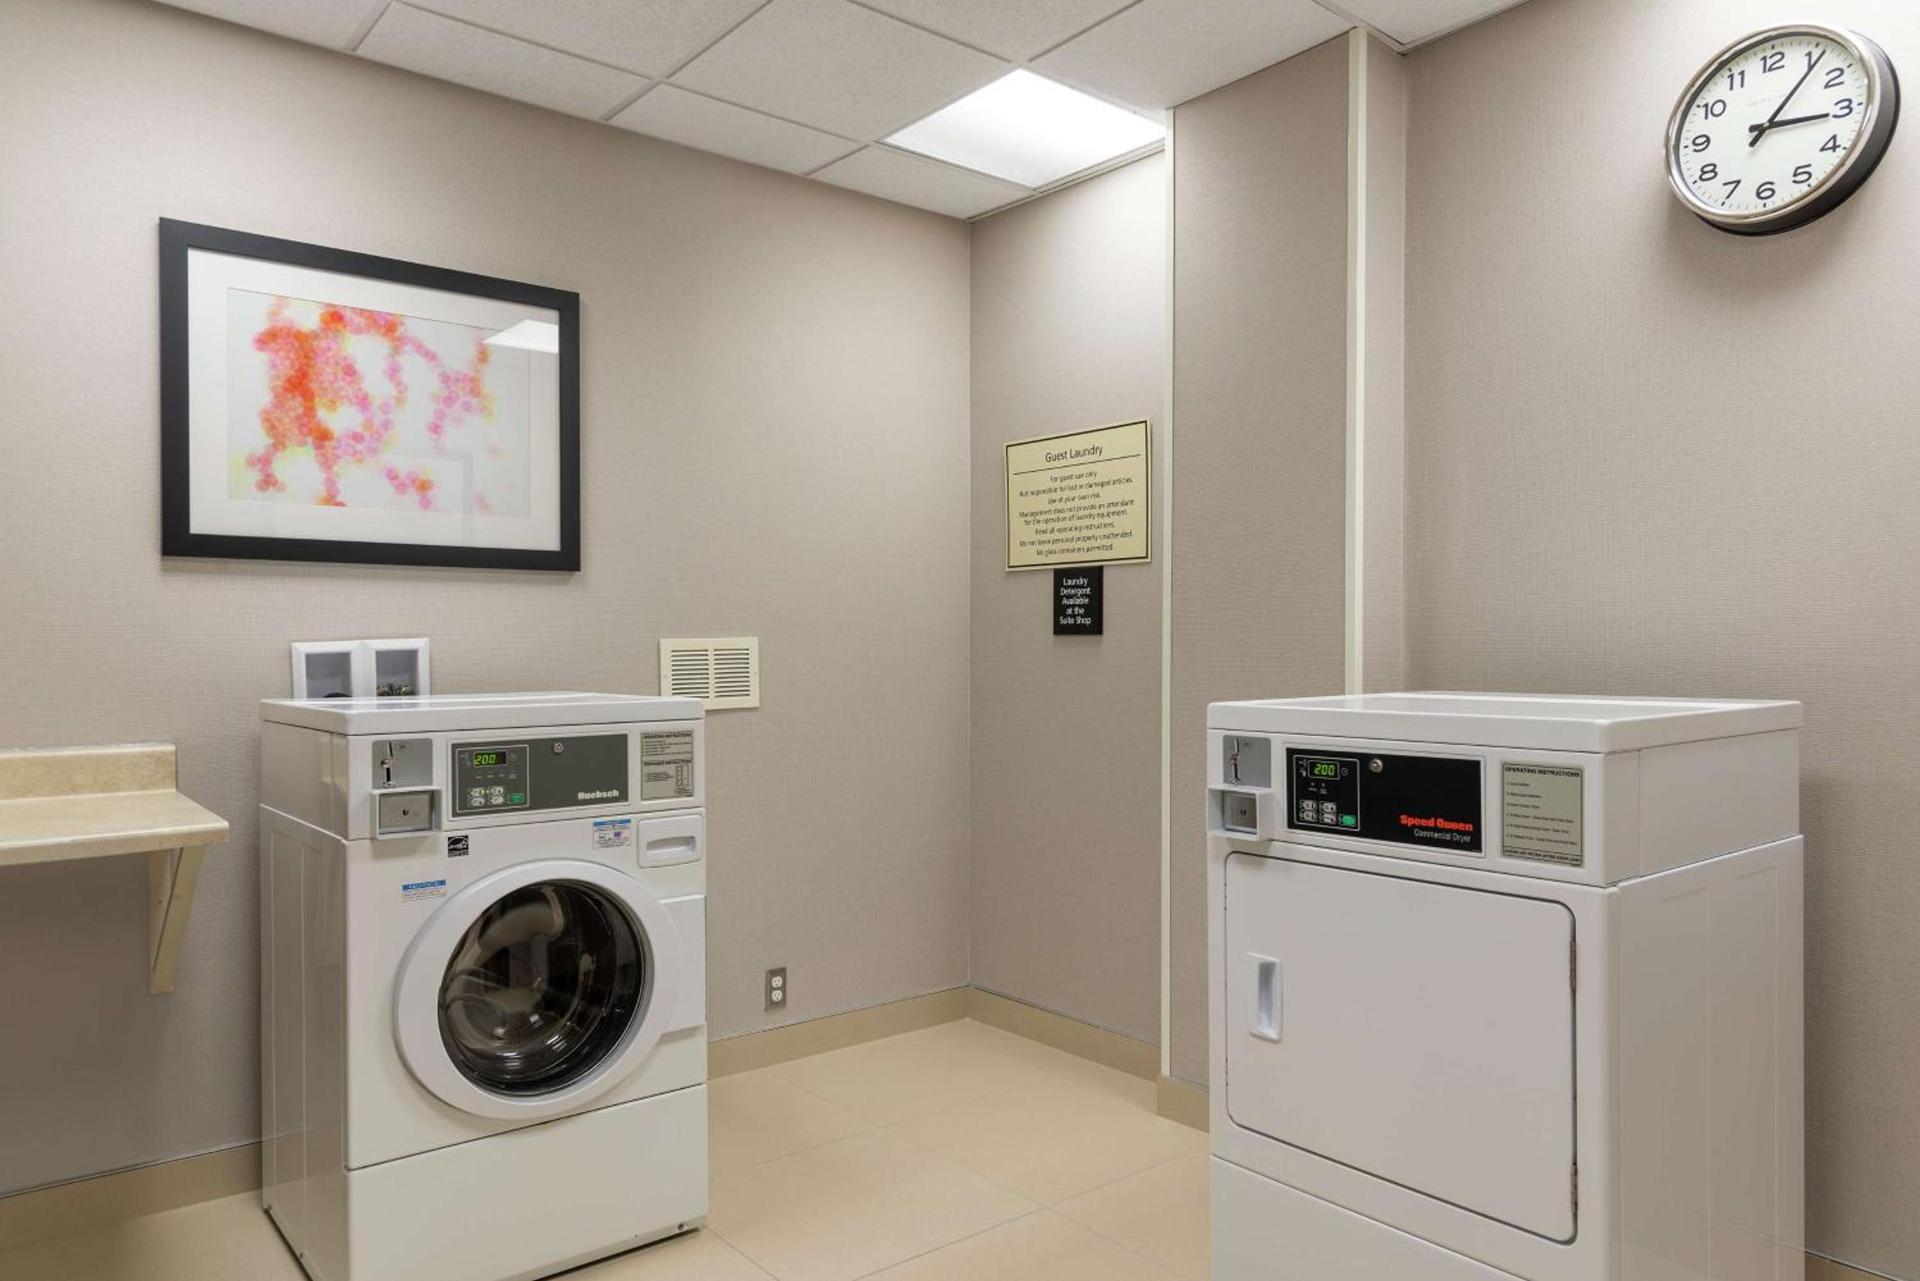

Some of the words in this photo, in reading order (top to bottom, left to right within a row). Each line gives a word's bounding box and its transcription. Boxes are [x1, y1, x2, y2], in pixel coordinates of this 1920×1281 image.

[1760, 51, 1785, 73] 12
[1804, 51, 1814, 69] 1
[1727, 70, 1746, 91] 11
[1823, 67, 1845, 89] 2
[1702, 99, 1727, 120] 10
[1831, 98, 1854, 118] 3
[1691, 134, 1711, 152] 9
[1819, 134, 1842, 153] 4
[1698, 163, 1718, 181] 8
[1792, 164, 1813, 184] 5
[1722, 179, 1742, 200] 7
[1755, 181, 1776, 200] 6
[1045, 450, 1068, 462] Guest
[1069, 444, 1103, 458] Laundry
[1060, 474, 1074, 482] guest
[1085, 480, 1111, 489] damaged
[1019, 508, 1053, 518] Management
[1075, 503, 1097, 512] provide
[1106, 499, 1134, 508] attendant
[1042, 516, 1067, 525] operation
[1076, 512, 1096, 520] laundry
[1056, 525, 1082, 533] operating
[1051, 536, 1074, 545] personal
[1075, 535, 1098, 543] property
[1063, 577, 1088, 587] Laundry
[1060, 587, 1091, 597] Detergent
[1062, 597, 1089, 605] Available
[1066, 607, 1073, 615] at
[1074, 606, 1085, 615] the
[1060, 616, 1075, 624] Suite
[1075, 616, 1092, 627] Shop
[473, 754, 497, 765] 200
[1314, 763, 1335, 776] 200
[1505, 766, 1537, 775] OPERATING
[1537, 769, 1580, 778] INSTRUCTIONS
[578, 789, 619, 800] Huebsch
[1400, 814, 1435, 827] Speed
[1436, 818, 1473, 831] Queen
[1414, 828, 1451, 840] Commercial
[1452, 832, 1472, 843] Dryer
